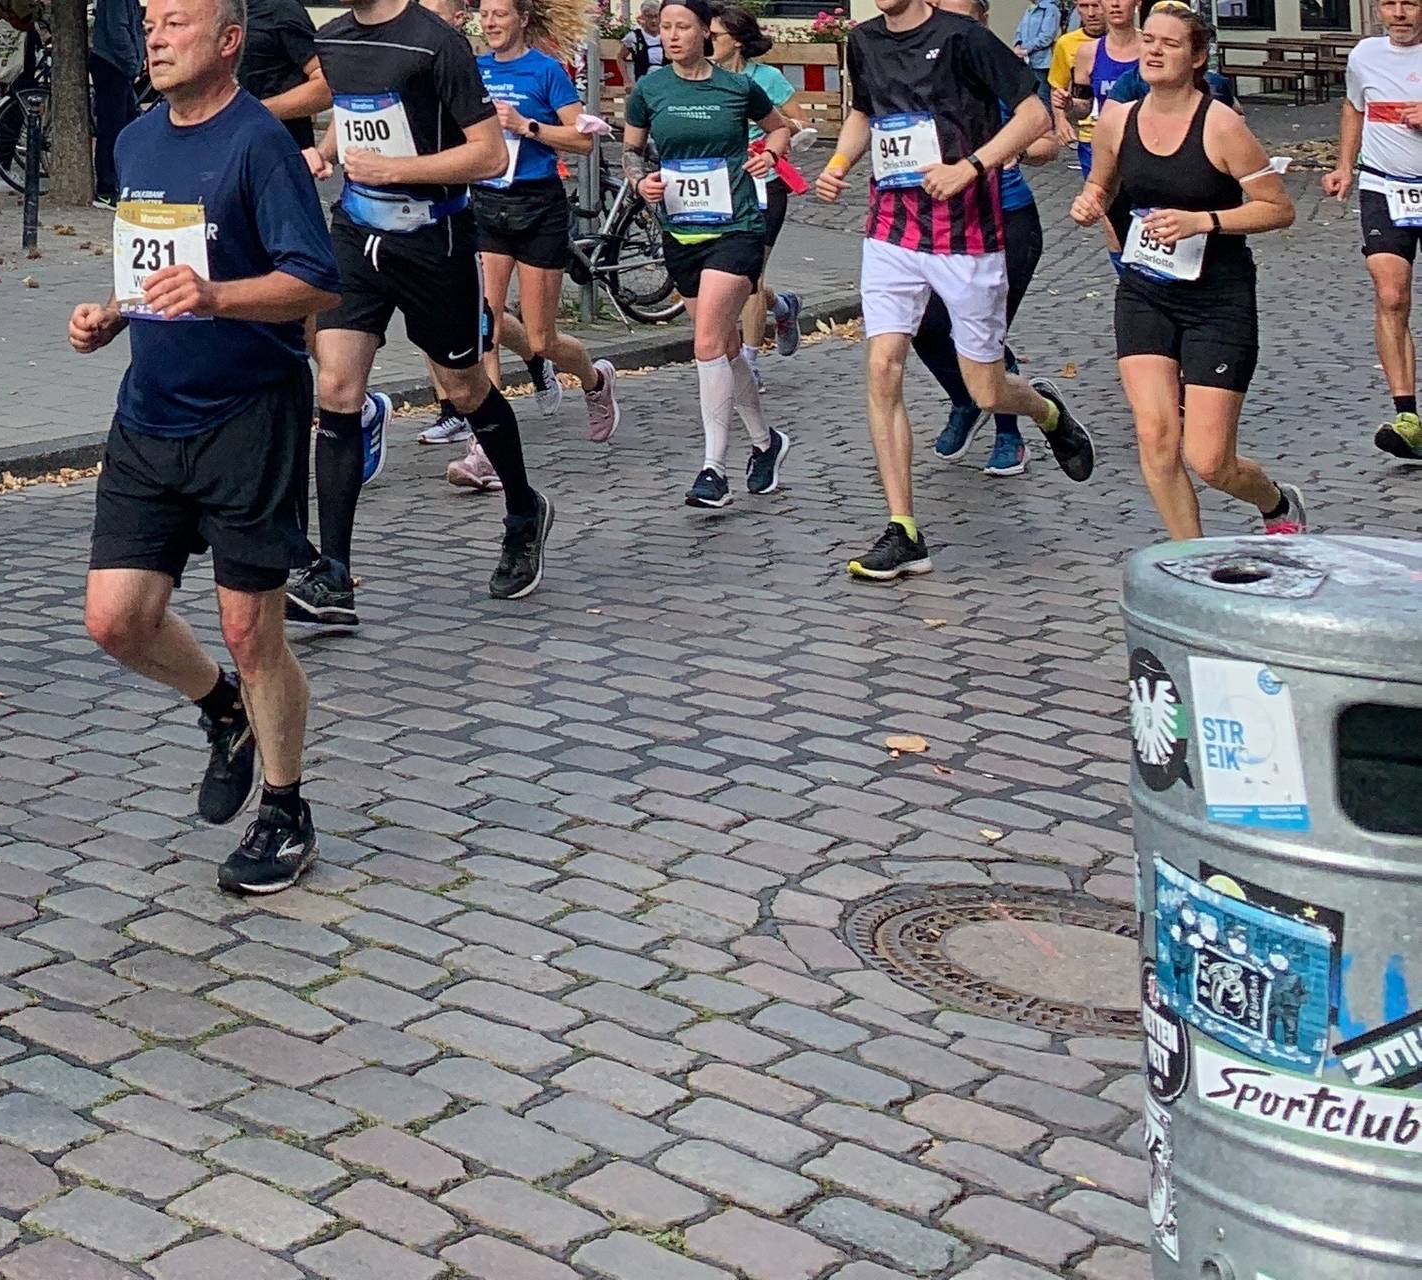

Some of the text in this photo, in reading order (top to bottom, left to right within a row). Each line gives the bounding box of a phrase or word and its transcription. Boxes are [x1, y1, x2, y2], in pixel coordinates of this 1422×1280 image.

[344, 119, 391, 142] 1500
[879, 135, 912, 159] 947
[676, 178, 711, 197] 791
[1396, 188, 1422, 205] 16
[132, 237, 176, 272] 231
[1202, 716, 1246, 745] STR
[1204, 744, 1242, 771] EIK
[1205, 1067, 1422, 1146] Sportclub
